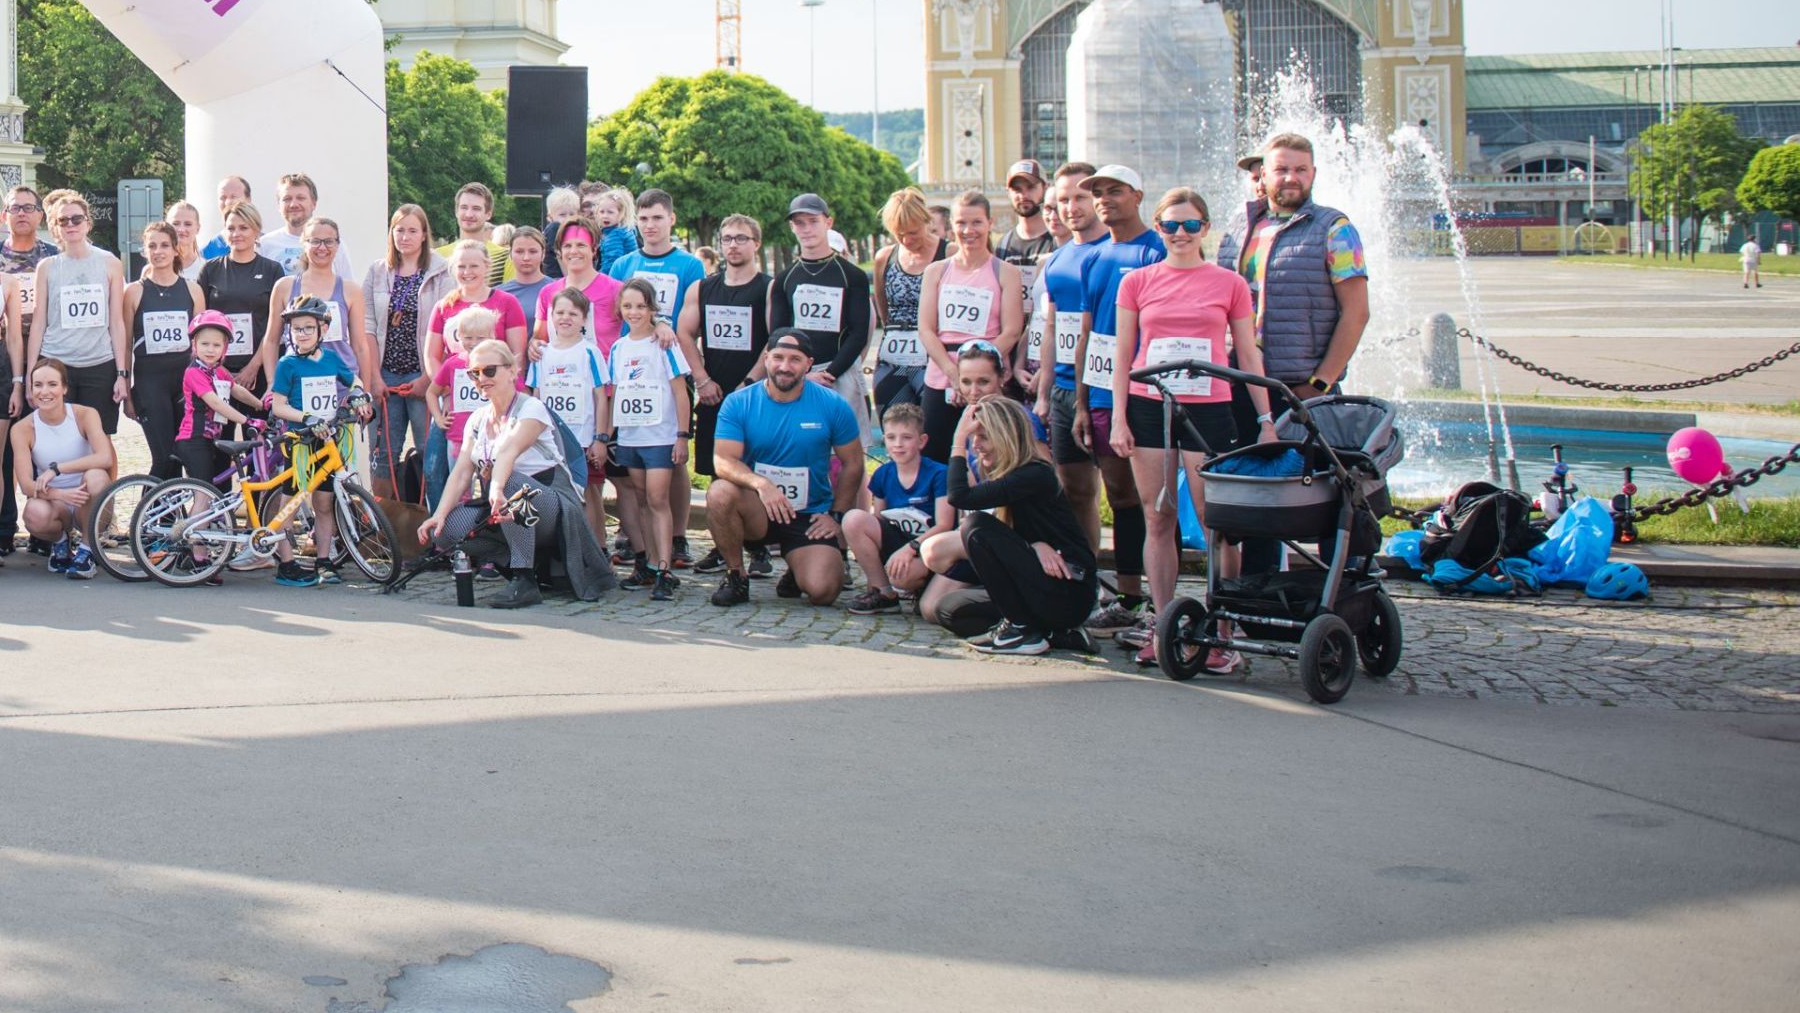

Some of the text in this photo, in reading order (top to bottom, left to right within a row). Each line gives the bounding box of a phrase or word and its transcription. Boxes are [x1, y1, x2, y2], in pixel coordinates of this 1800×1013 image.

[68, 301, 99, 317] 070
[800, 303, 832, 320] 022
[945, 303, 980, 322] 079
[152, 328, 182, 343] 048
[713, 323, 743, 338] 023
[888, 339, 918, 355] 071
[546, 396, 576, 412] 086
[621, 398, 653, 414] 085
